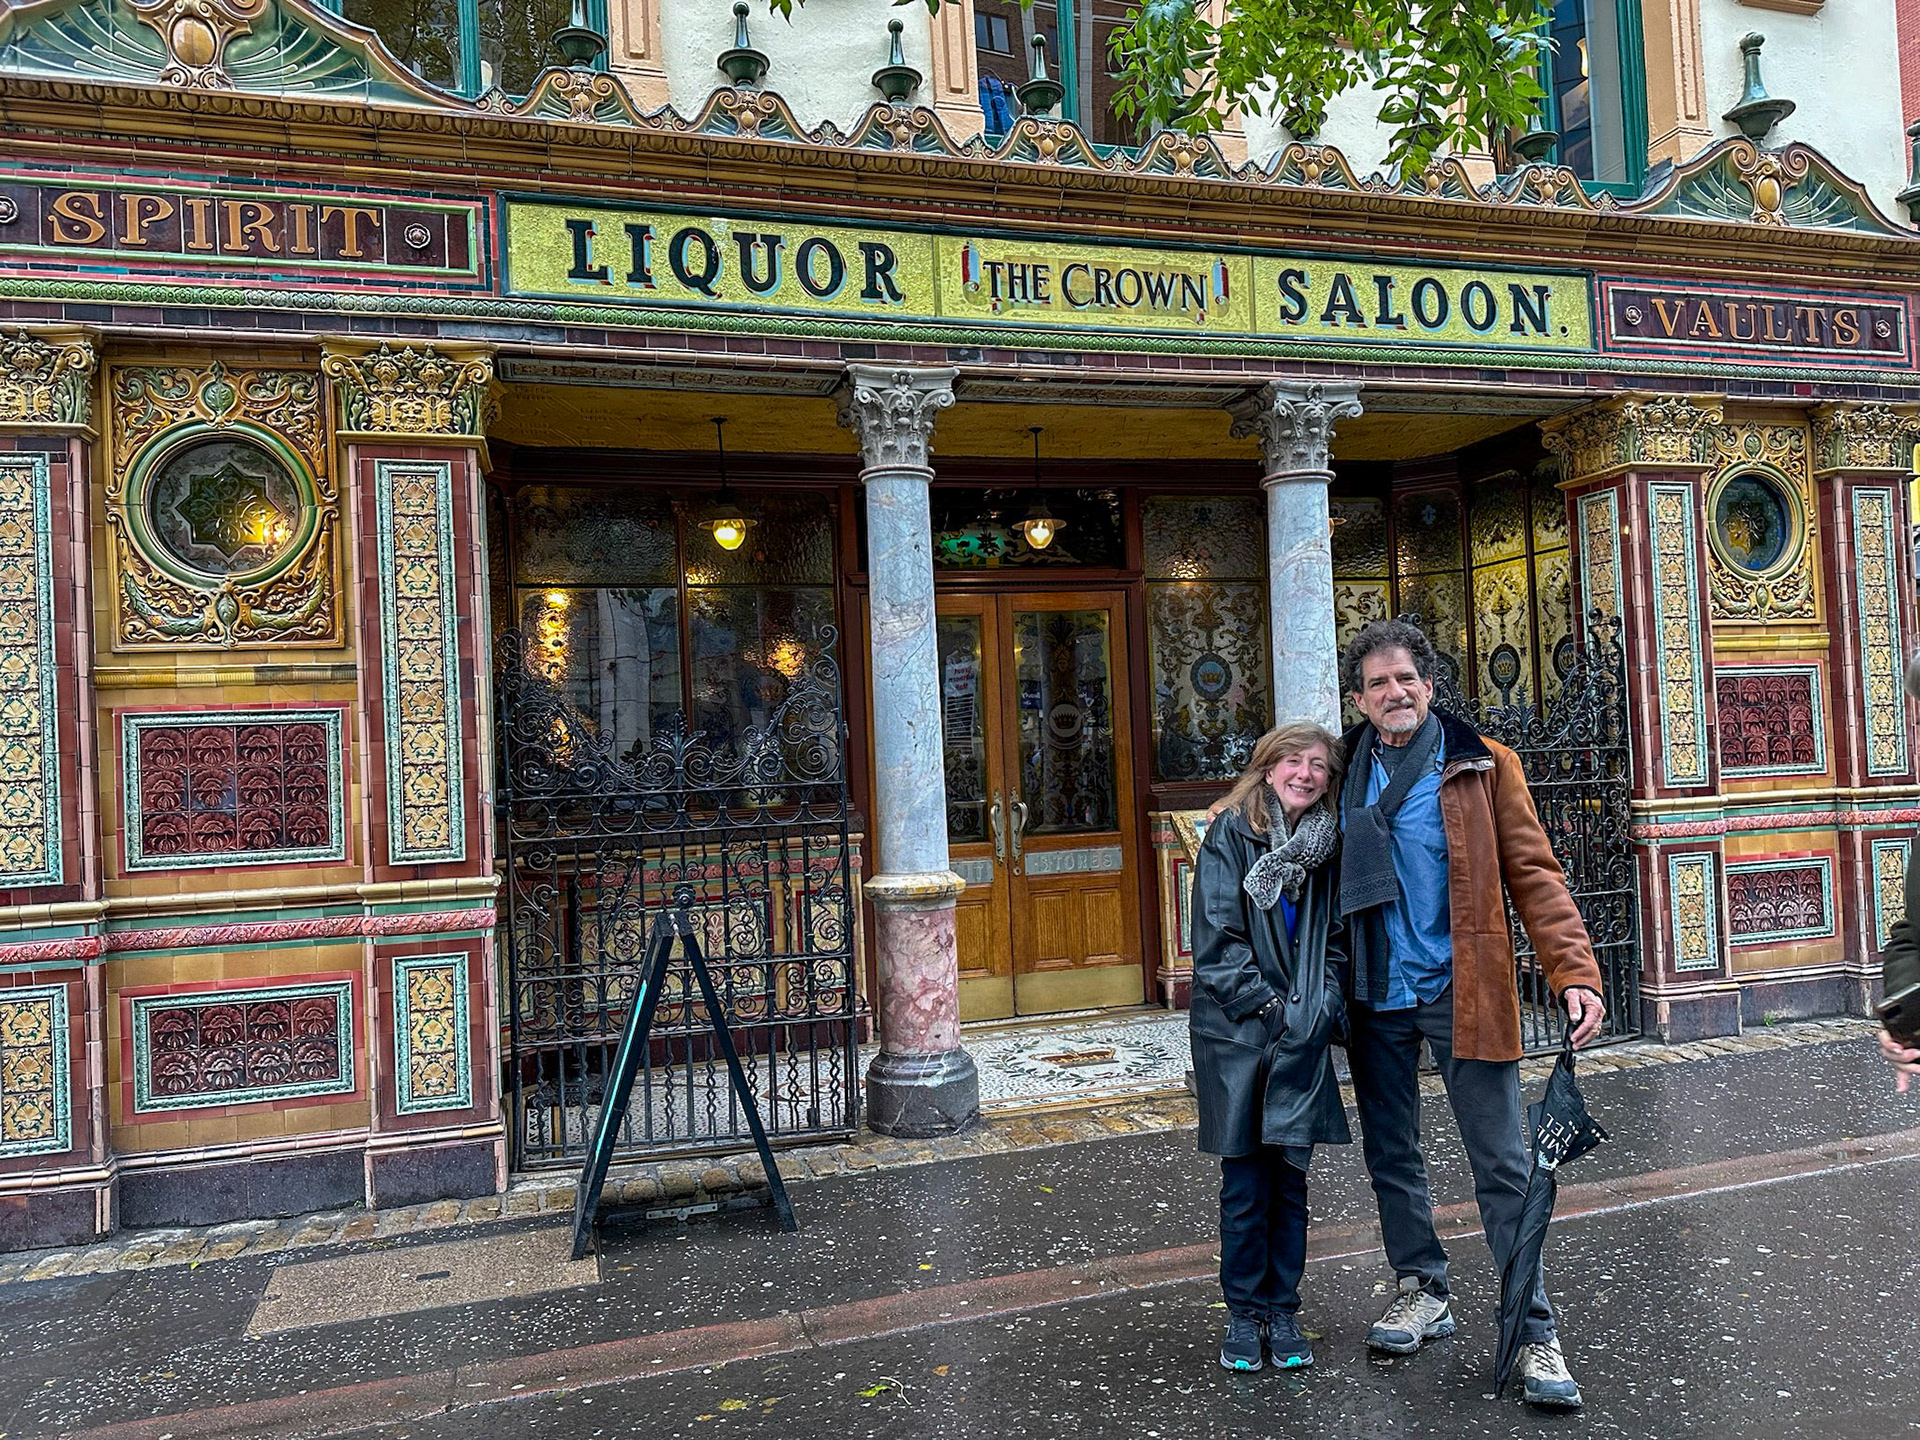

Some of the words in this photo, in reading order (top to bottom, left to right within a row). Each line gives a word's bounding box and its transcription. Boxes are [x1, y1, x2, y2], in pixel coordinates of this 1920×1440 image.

[48, 192, 380, 258] SPIRIT
[565, 218, 906, 306] LIQUOR
[982, 260, 1051, 304] THE
[1061, 262, 1208, 313] CROWN
[1277, 268, 1570, 338] SALOON.
[1650, 298, 1861, 345] VAULTS
[1038, 853, 1113, 873] STORES
